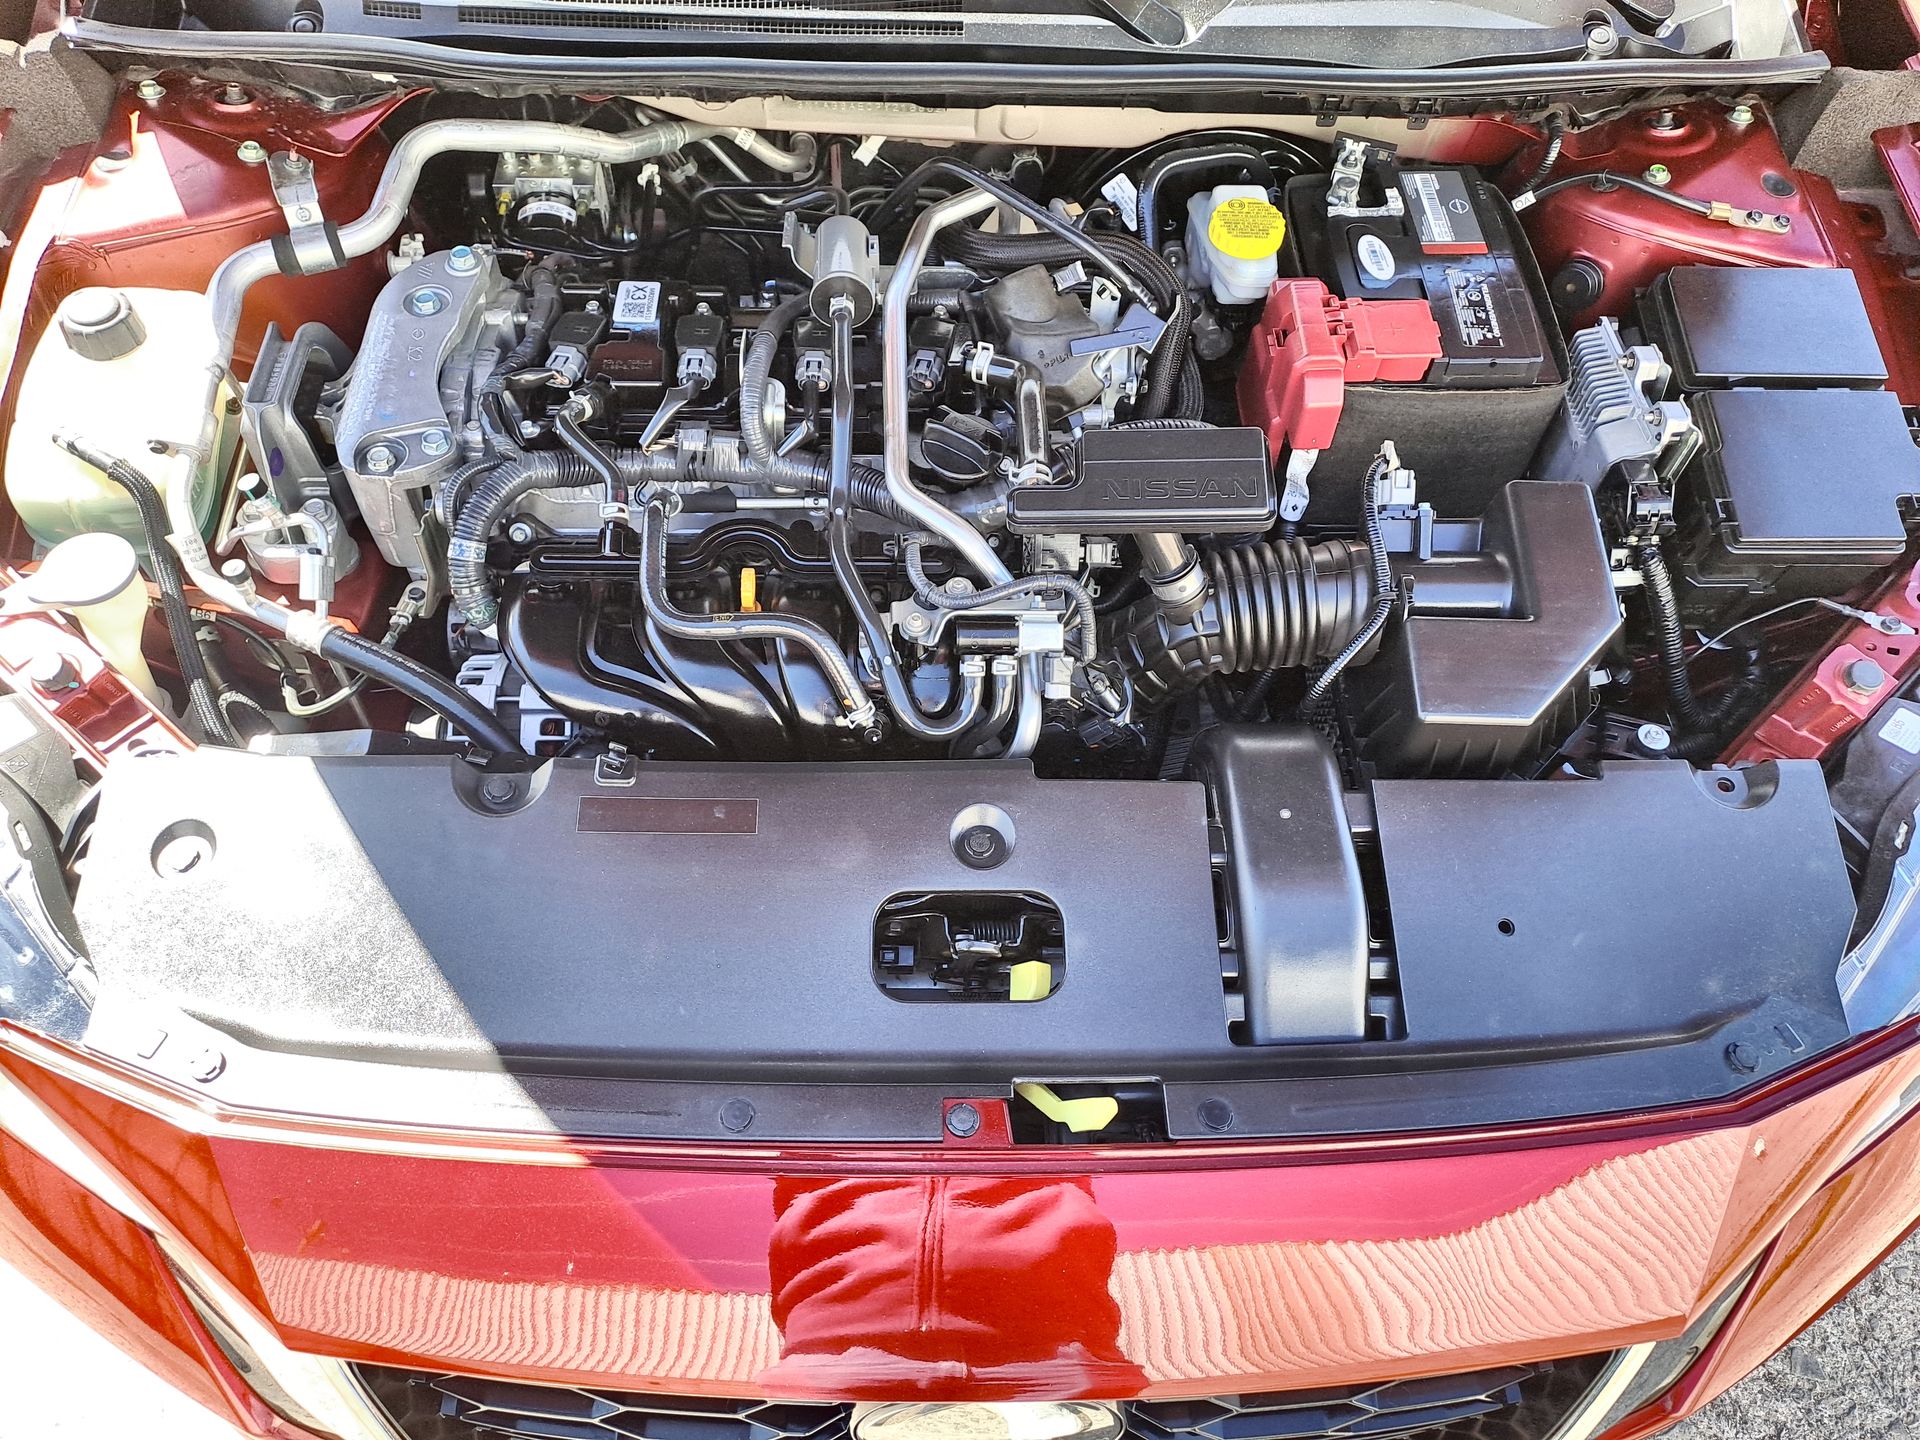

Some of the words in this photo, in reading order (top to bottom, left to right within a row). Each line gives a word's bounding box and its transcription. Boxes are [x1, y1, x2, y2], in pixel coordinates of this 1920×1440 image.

[631, 285, 648, 301] X3
[1102, 476, 1258, 501] NISSAN
[195, 609, 212, 620] B6
